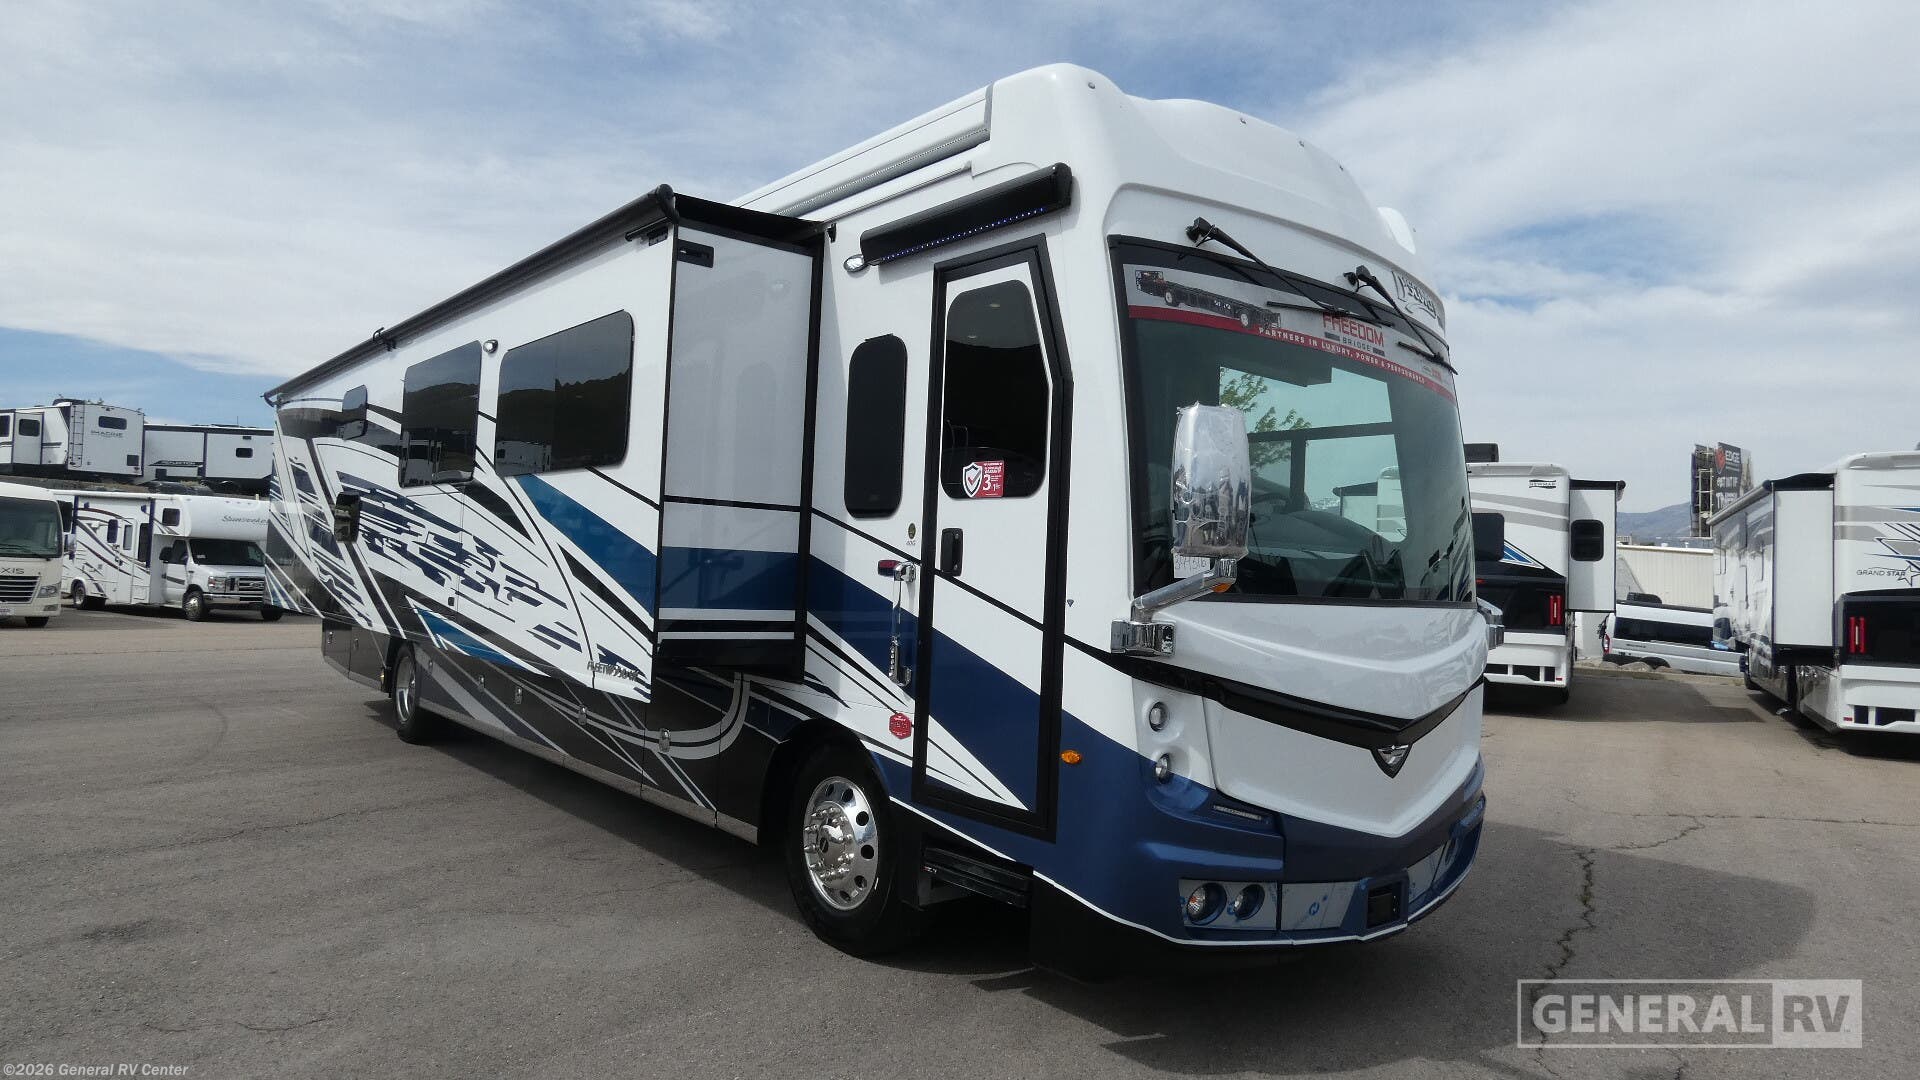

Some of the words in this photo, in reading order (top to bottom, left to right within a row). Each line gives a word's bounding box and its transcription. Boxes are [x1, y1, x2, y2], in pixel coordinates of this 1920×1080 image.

[1323, 312, 1384, 347] FREEDOM
[1259, 327, 1304, 343] PARTNERS
[1309, 338, 1318, 346] IN
[1356, 353, 1379, 364] POWER
[1343, 337, 1371, 351] BRIDGE
[1725, 450, 1740, 464] EDGE
[982, 474, 991, 490] 3
